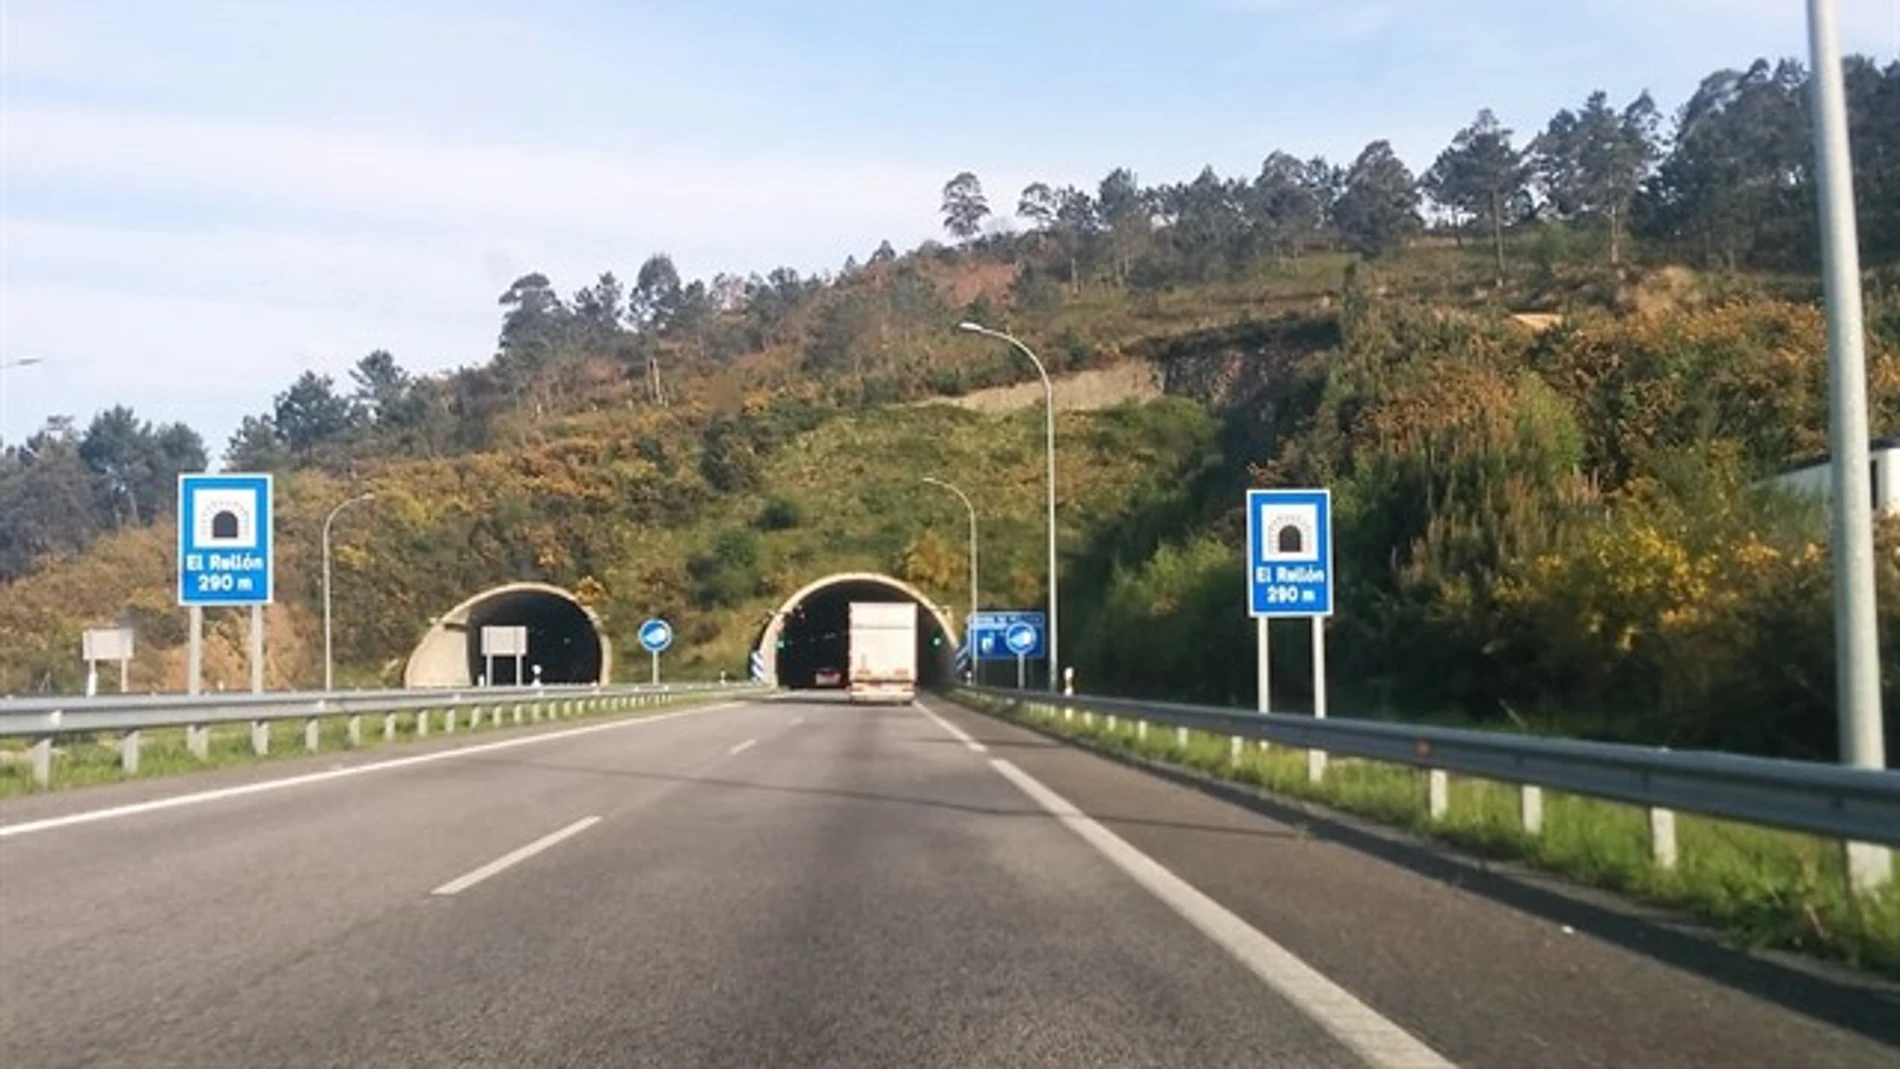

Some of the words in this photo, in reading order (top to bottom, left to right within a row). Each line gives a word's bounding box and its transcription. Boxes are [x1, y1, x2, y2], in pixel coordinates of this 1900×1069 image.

[186, 554, 204, 571] El
[198, 573, 234, 592] 290
[237, 577, 253, 592] m
[1256, 566, 1272, 583] El
[1267, 584, 1299, 603] 290
[1302, 589, 1316, 603] m
